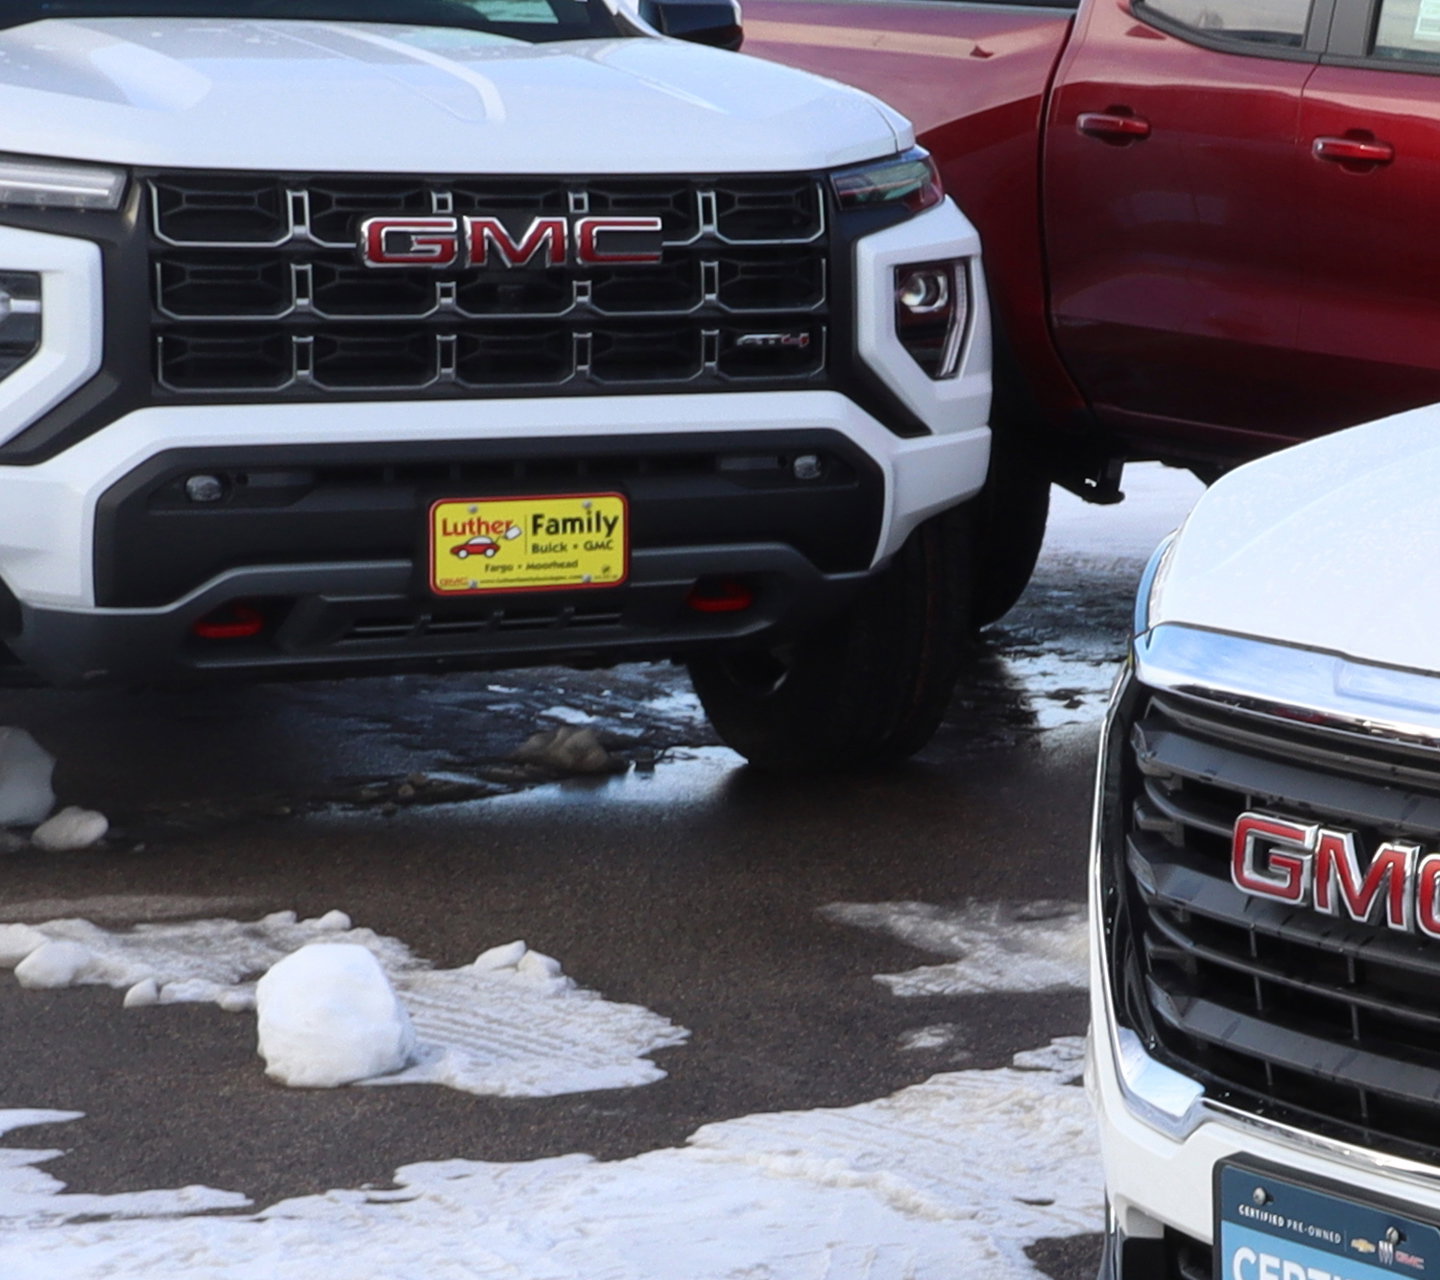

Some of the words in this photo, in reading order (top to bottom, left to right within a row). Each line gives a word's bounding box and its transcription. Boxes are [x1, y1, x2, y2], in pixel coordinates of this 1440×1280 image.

[360, 216, 662, 268] GMC
[442, 517, 514, 537] Luther
[532, 510, 620, 538] Family
[532, 542, 568, 554] Buick
[584, 539, 614, 552] GMC
[484, 563, 514, 574] Fargo
[526, 560, 579, 572] Moorhead
[1238, 1203, 1285, 1228] CERTIFIED
[1287, 1218, 1342, 1245] PRE-OWNED
[1395, 1250, 1425, 1270] GMC
